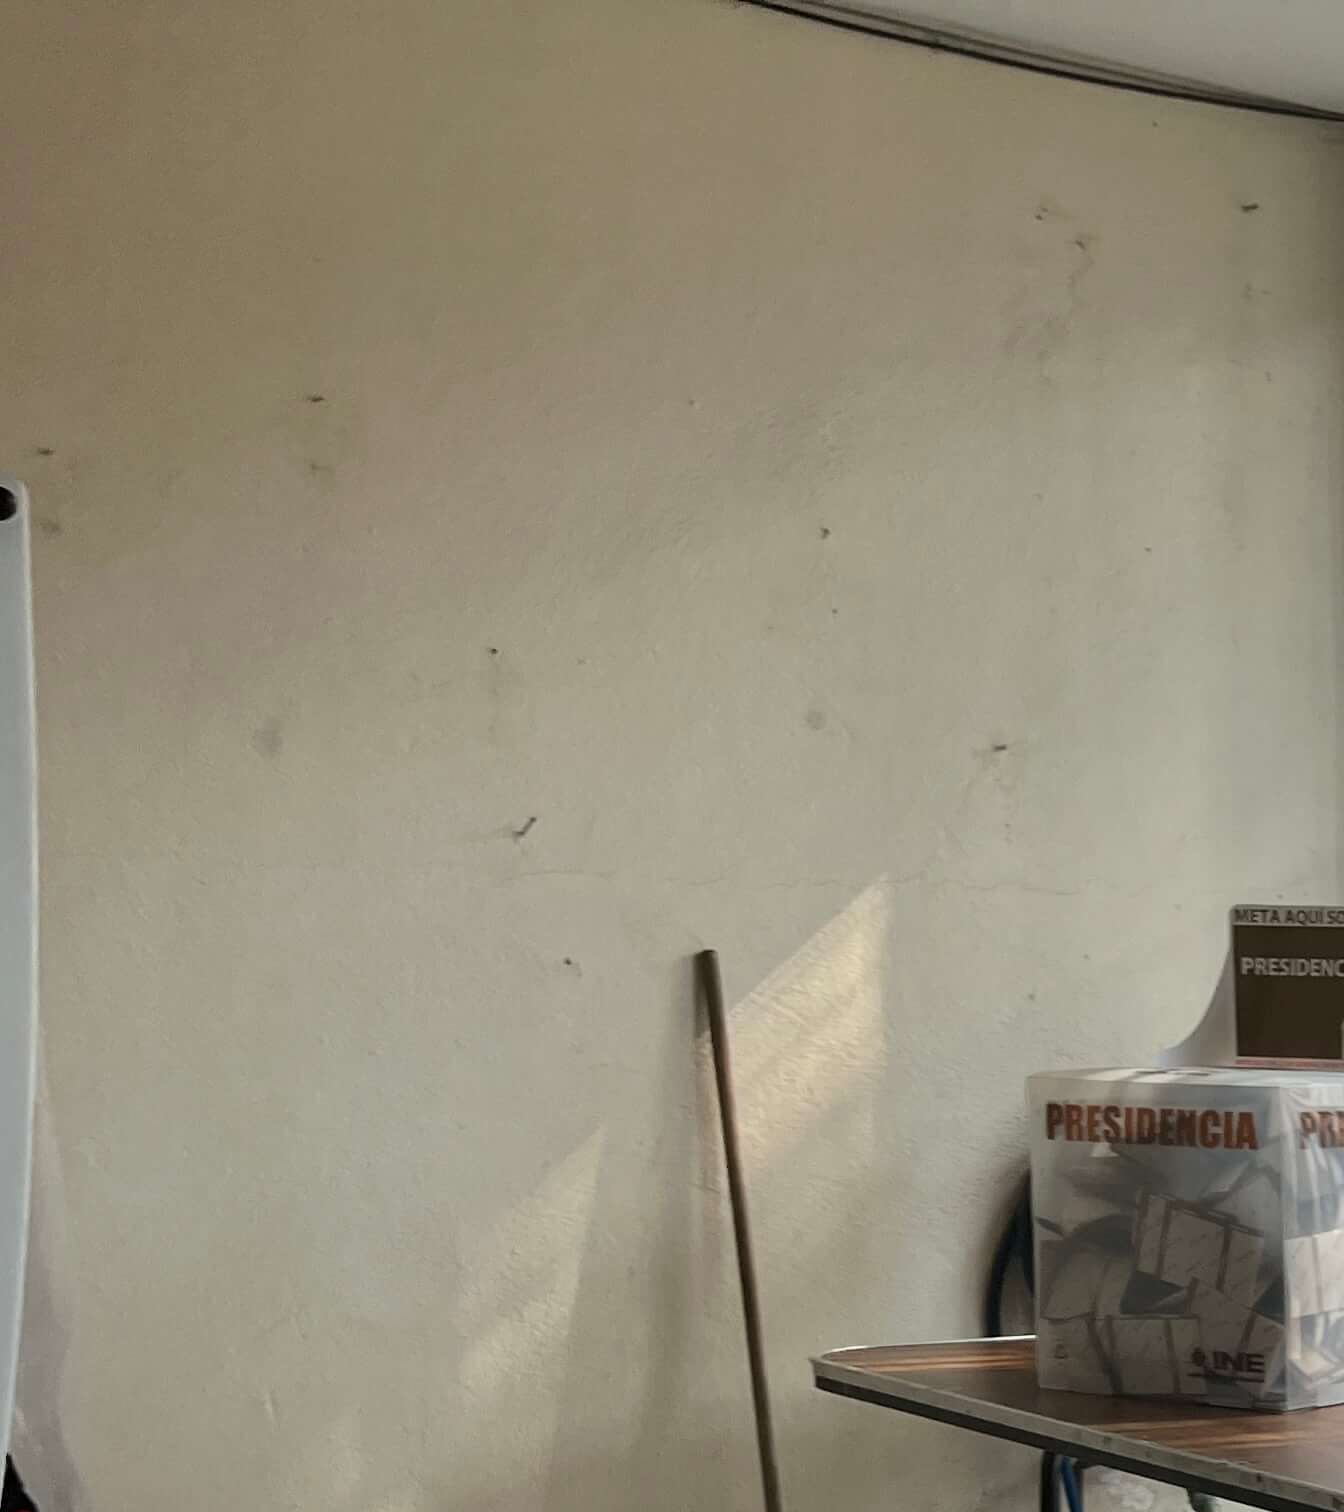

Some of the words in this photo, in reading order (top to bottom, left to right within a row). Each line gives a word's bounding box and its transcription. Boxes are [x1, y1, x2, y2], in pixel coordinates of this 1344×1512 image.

[1234, 908, 1280, 924] META
[1045, 1102, 1259, 1151] PRESIDENCIA
[1210, 1350, 1265, 1373] INE
